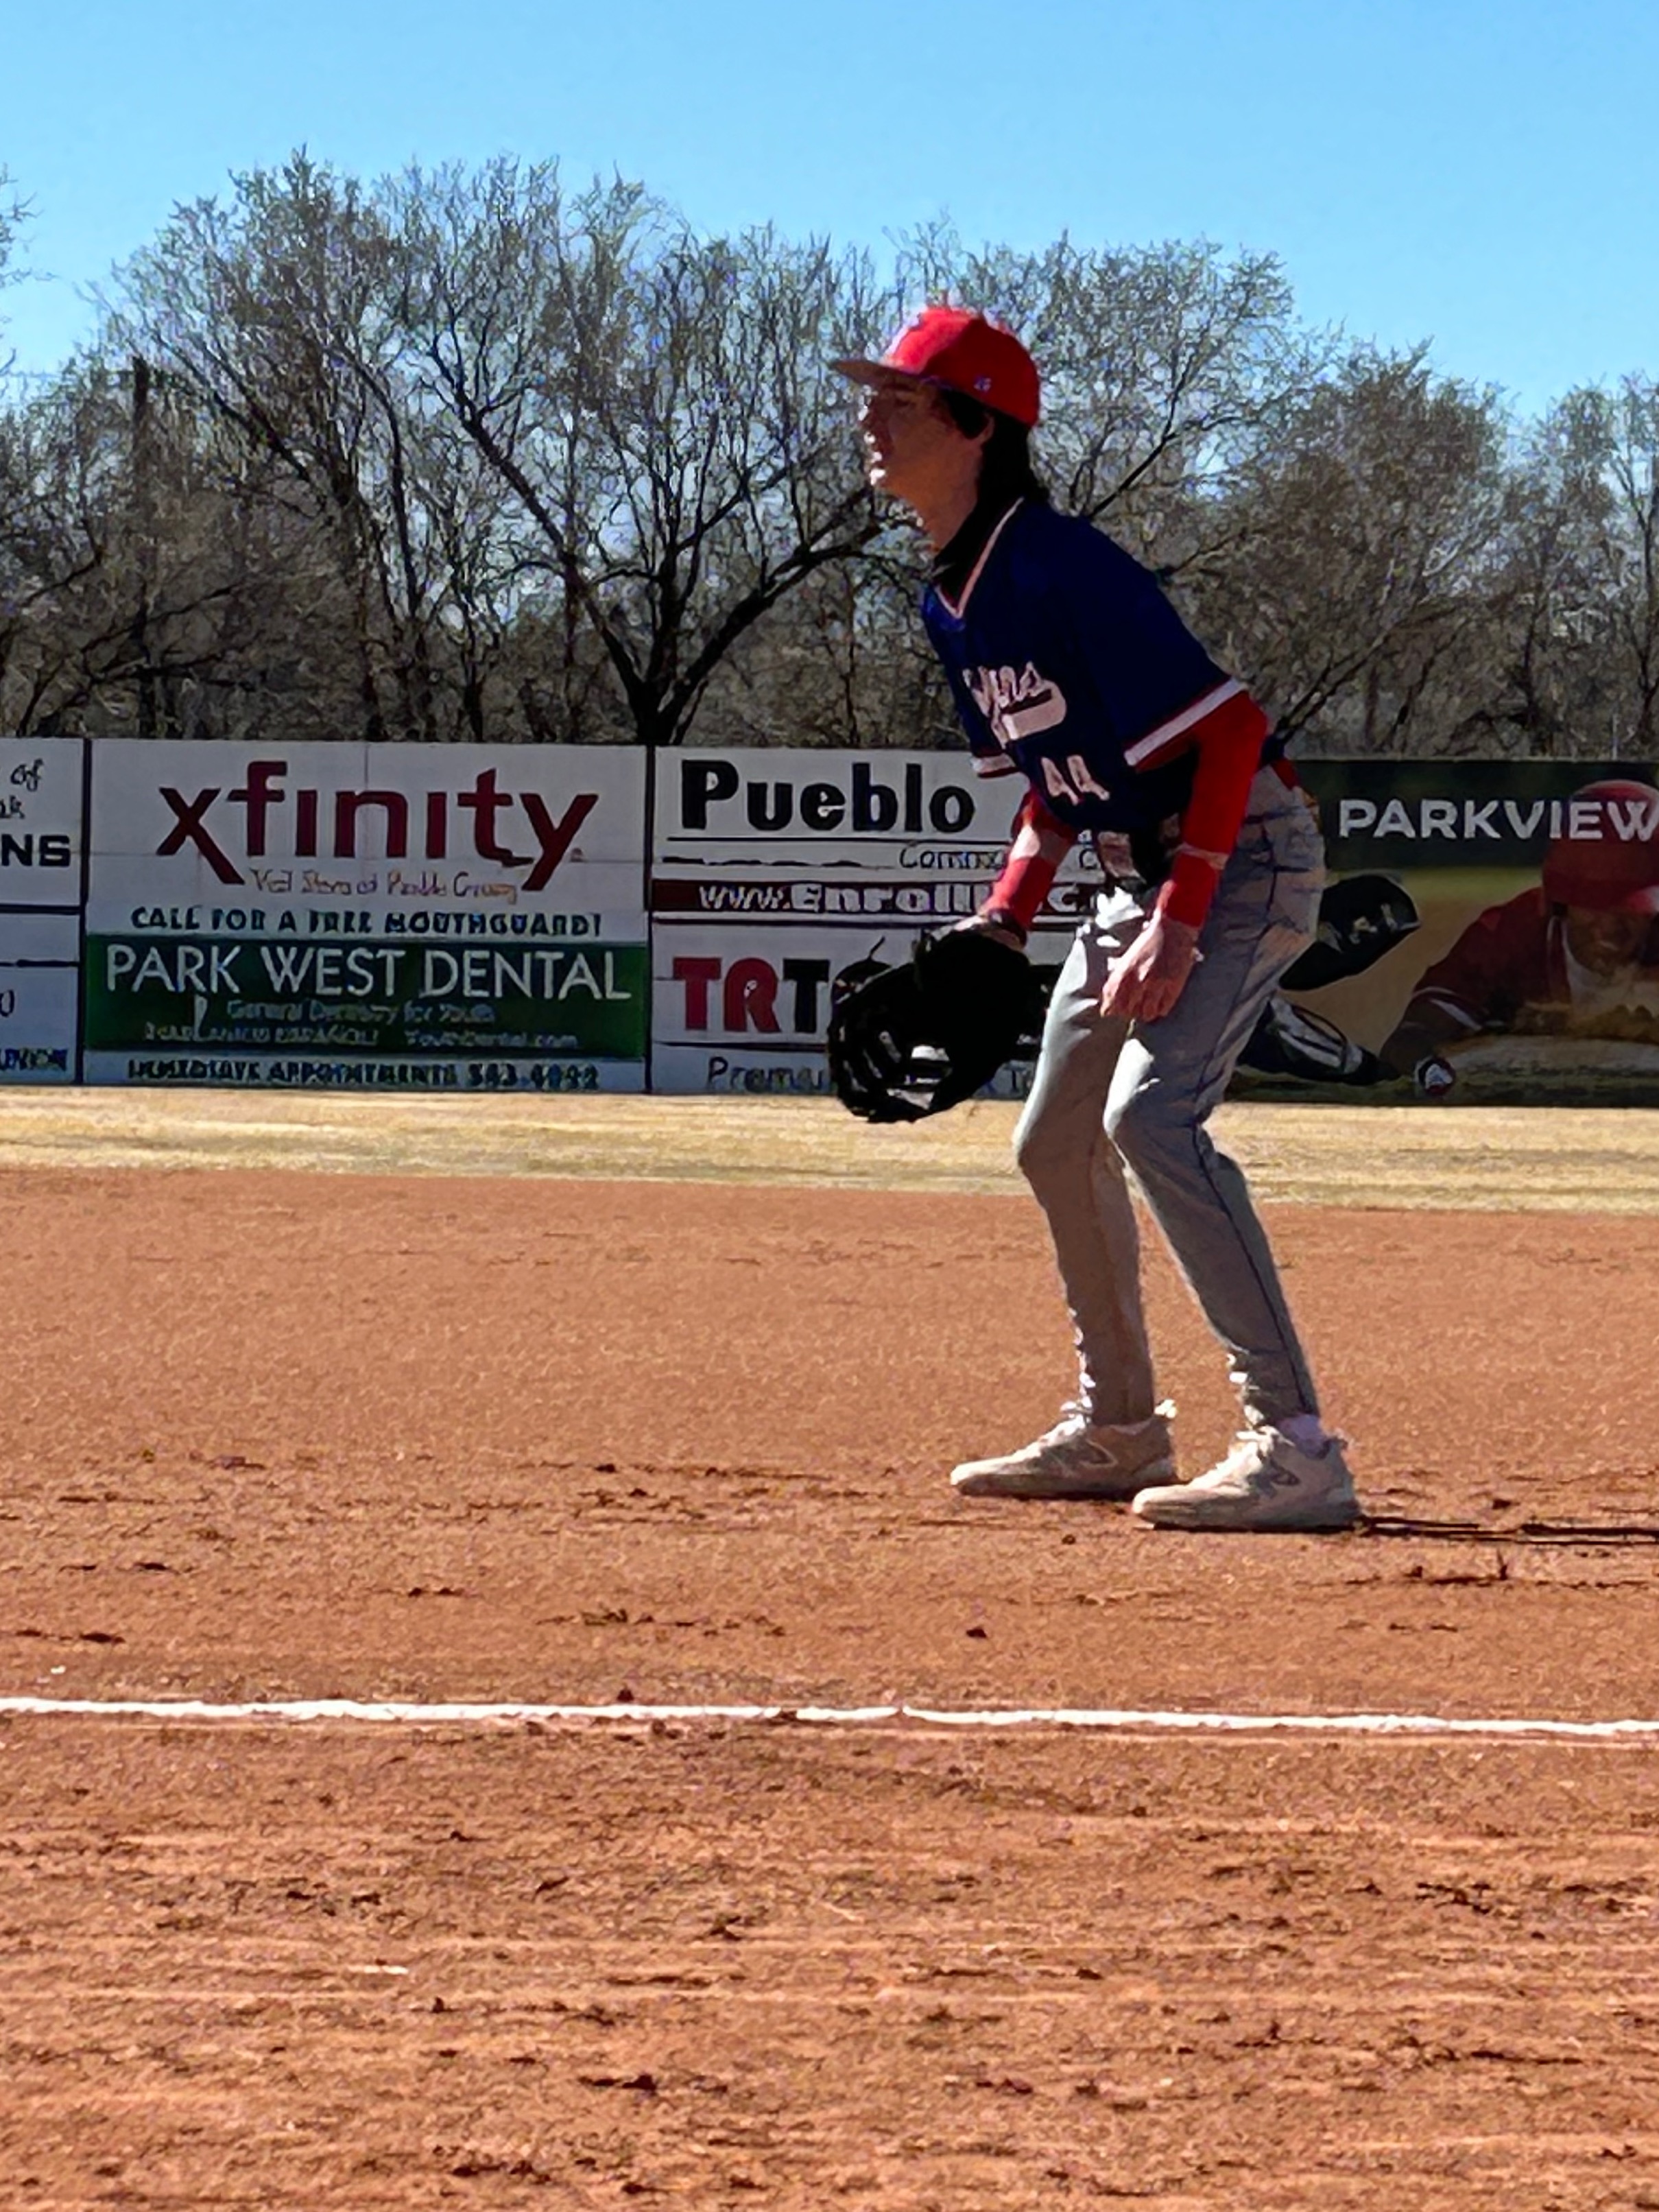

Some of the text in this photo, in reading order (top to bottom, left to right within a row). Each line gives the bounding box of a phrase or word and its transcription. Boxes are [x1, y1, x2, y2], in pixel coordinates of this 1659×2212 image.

[681, 759, 975, 833] Pueblo
[1338, 798, 1659, 842] PARKVIEW
[156, 761, 599, 891] xfinity
[131, 906, 202, 931] CALL
[278, 910, 297, 932] A
[108, 944, 632, 1001] PARK WEST DENTAL
